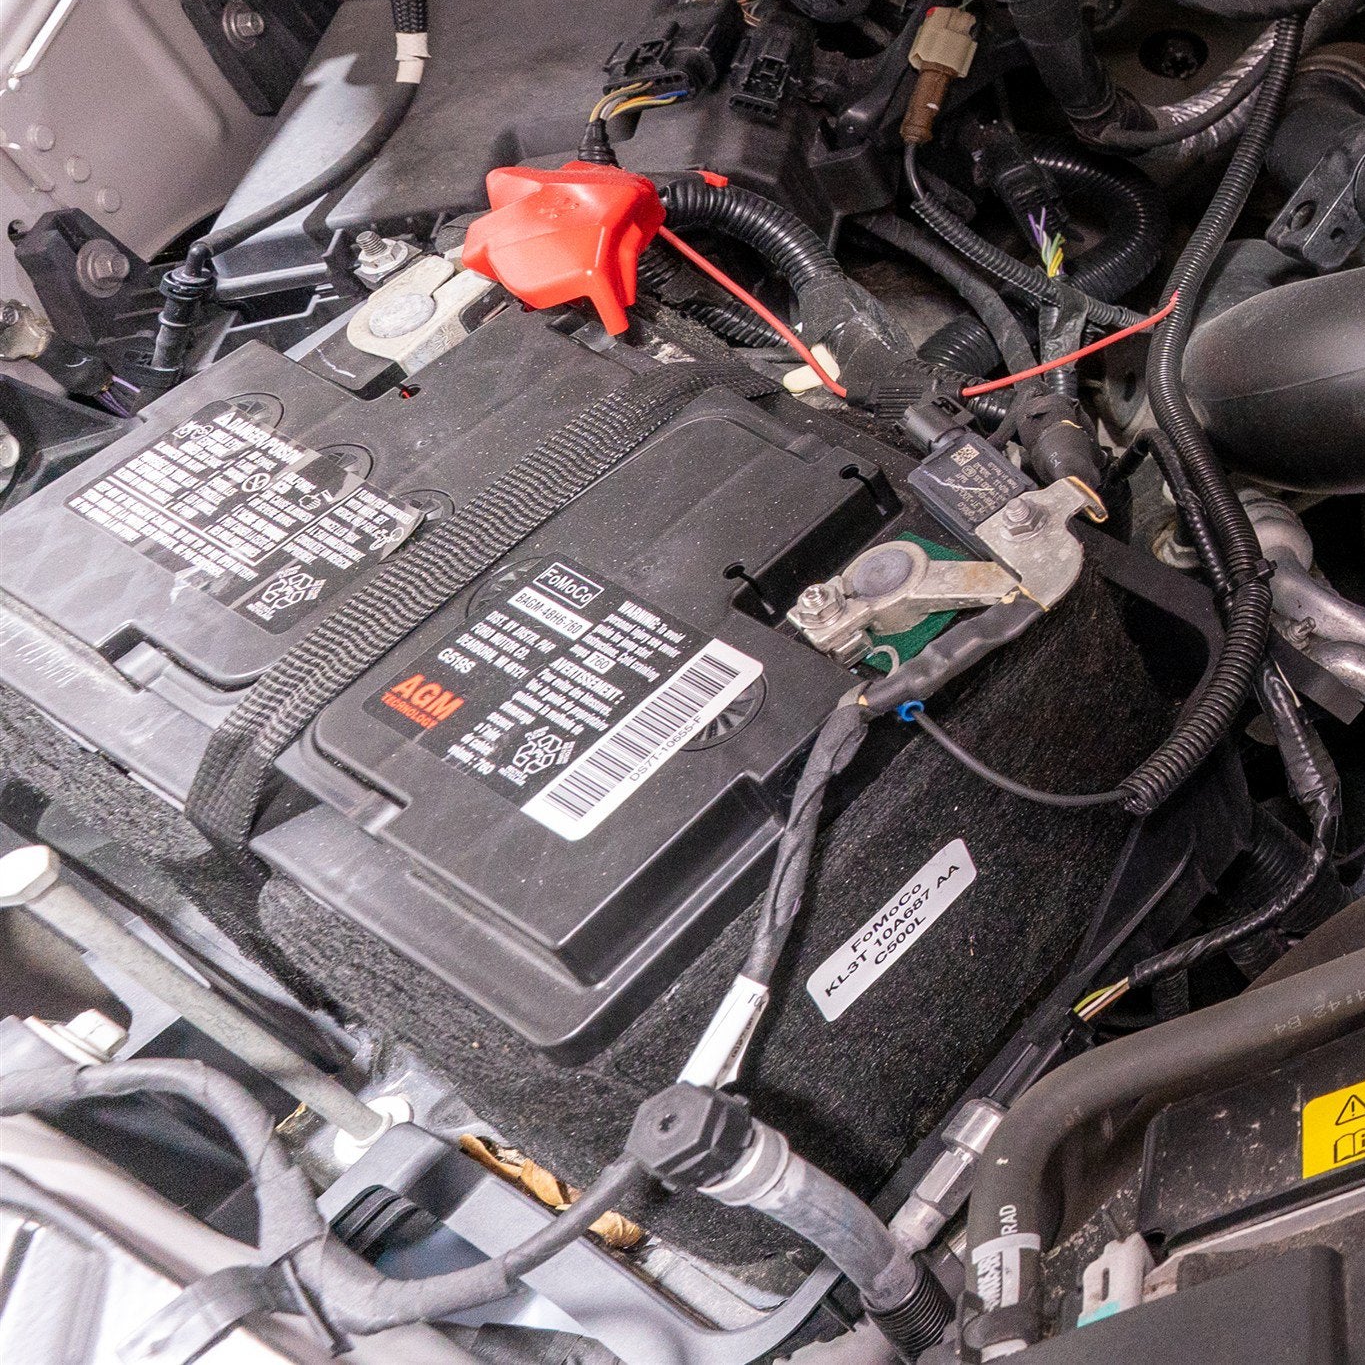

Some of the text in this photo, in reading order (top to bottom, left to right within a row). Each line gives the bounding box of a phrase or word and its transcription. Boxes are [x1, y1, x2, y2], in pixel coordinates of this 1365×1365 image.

[539, 567, 597, 603] FoMoCo
[513, 592, 584, 635] BAGM-48H6-760
[468, 621, 496, 639] FORD
[487, 632, 521, 653] MOTOR
[434, 647, 477, 674] G519S
[587, 654, 611, 670] 760
[376, 691, 440, 730] TECHNOLOGY
[389, 671, 467, 720] AGM
[824, 864, 960, 997] KL3T 10A687 AA
[850, 883, 922, 953] FoMoCo
[874, 916, 926, 965] C500L
[999, 1204, 1018, 1234] RAD
